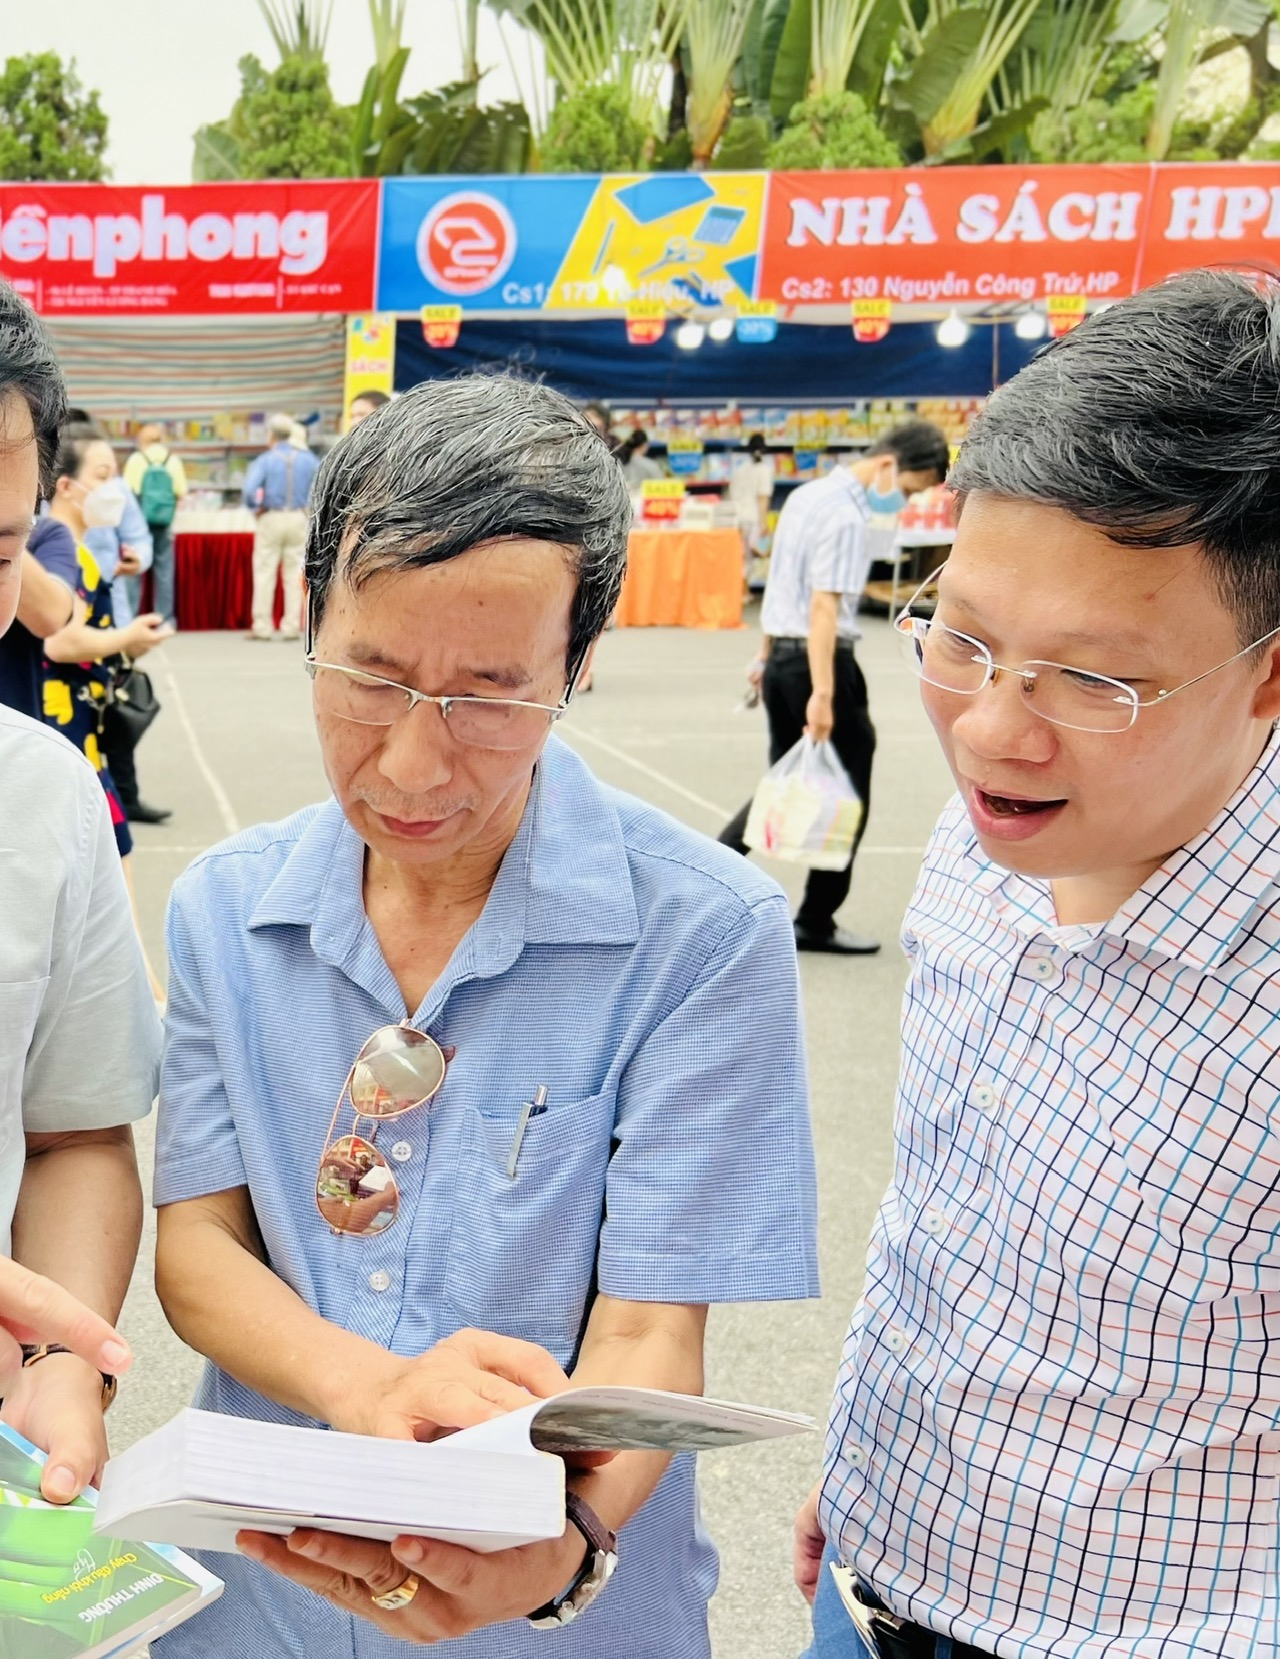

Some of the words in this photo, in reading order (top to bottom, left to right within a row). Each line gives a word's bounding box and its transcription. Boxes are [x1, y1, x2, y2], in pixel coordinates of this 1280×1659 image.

[786, 182, 938, 247] NHÀ
[956, 180, 1142, 243] SÁCH
[781, 276, 833, 300] Cs2:
[840, 276, 879, 299] 130
[975, 273, 1036, 300] Công
